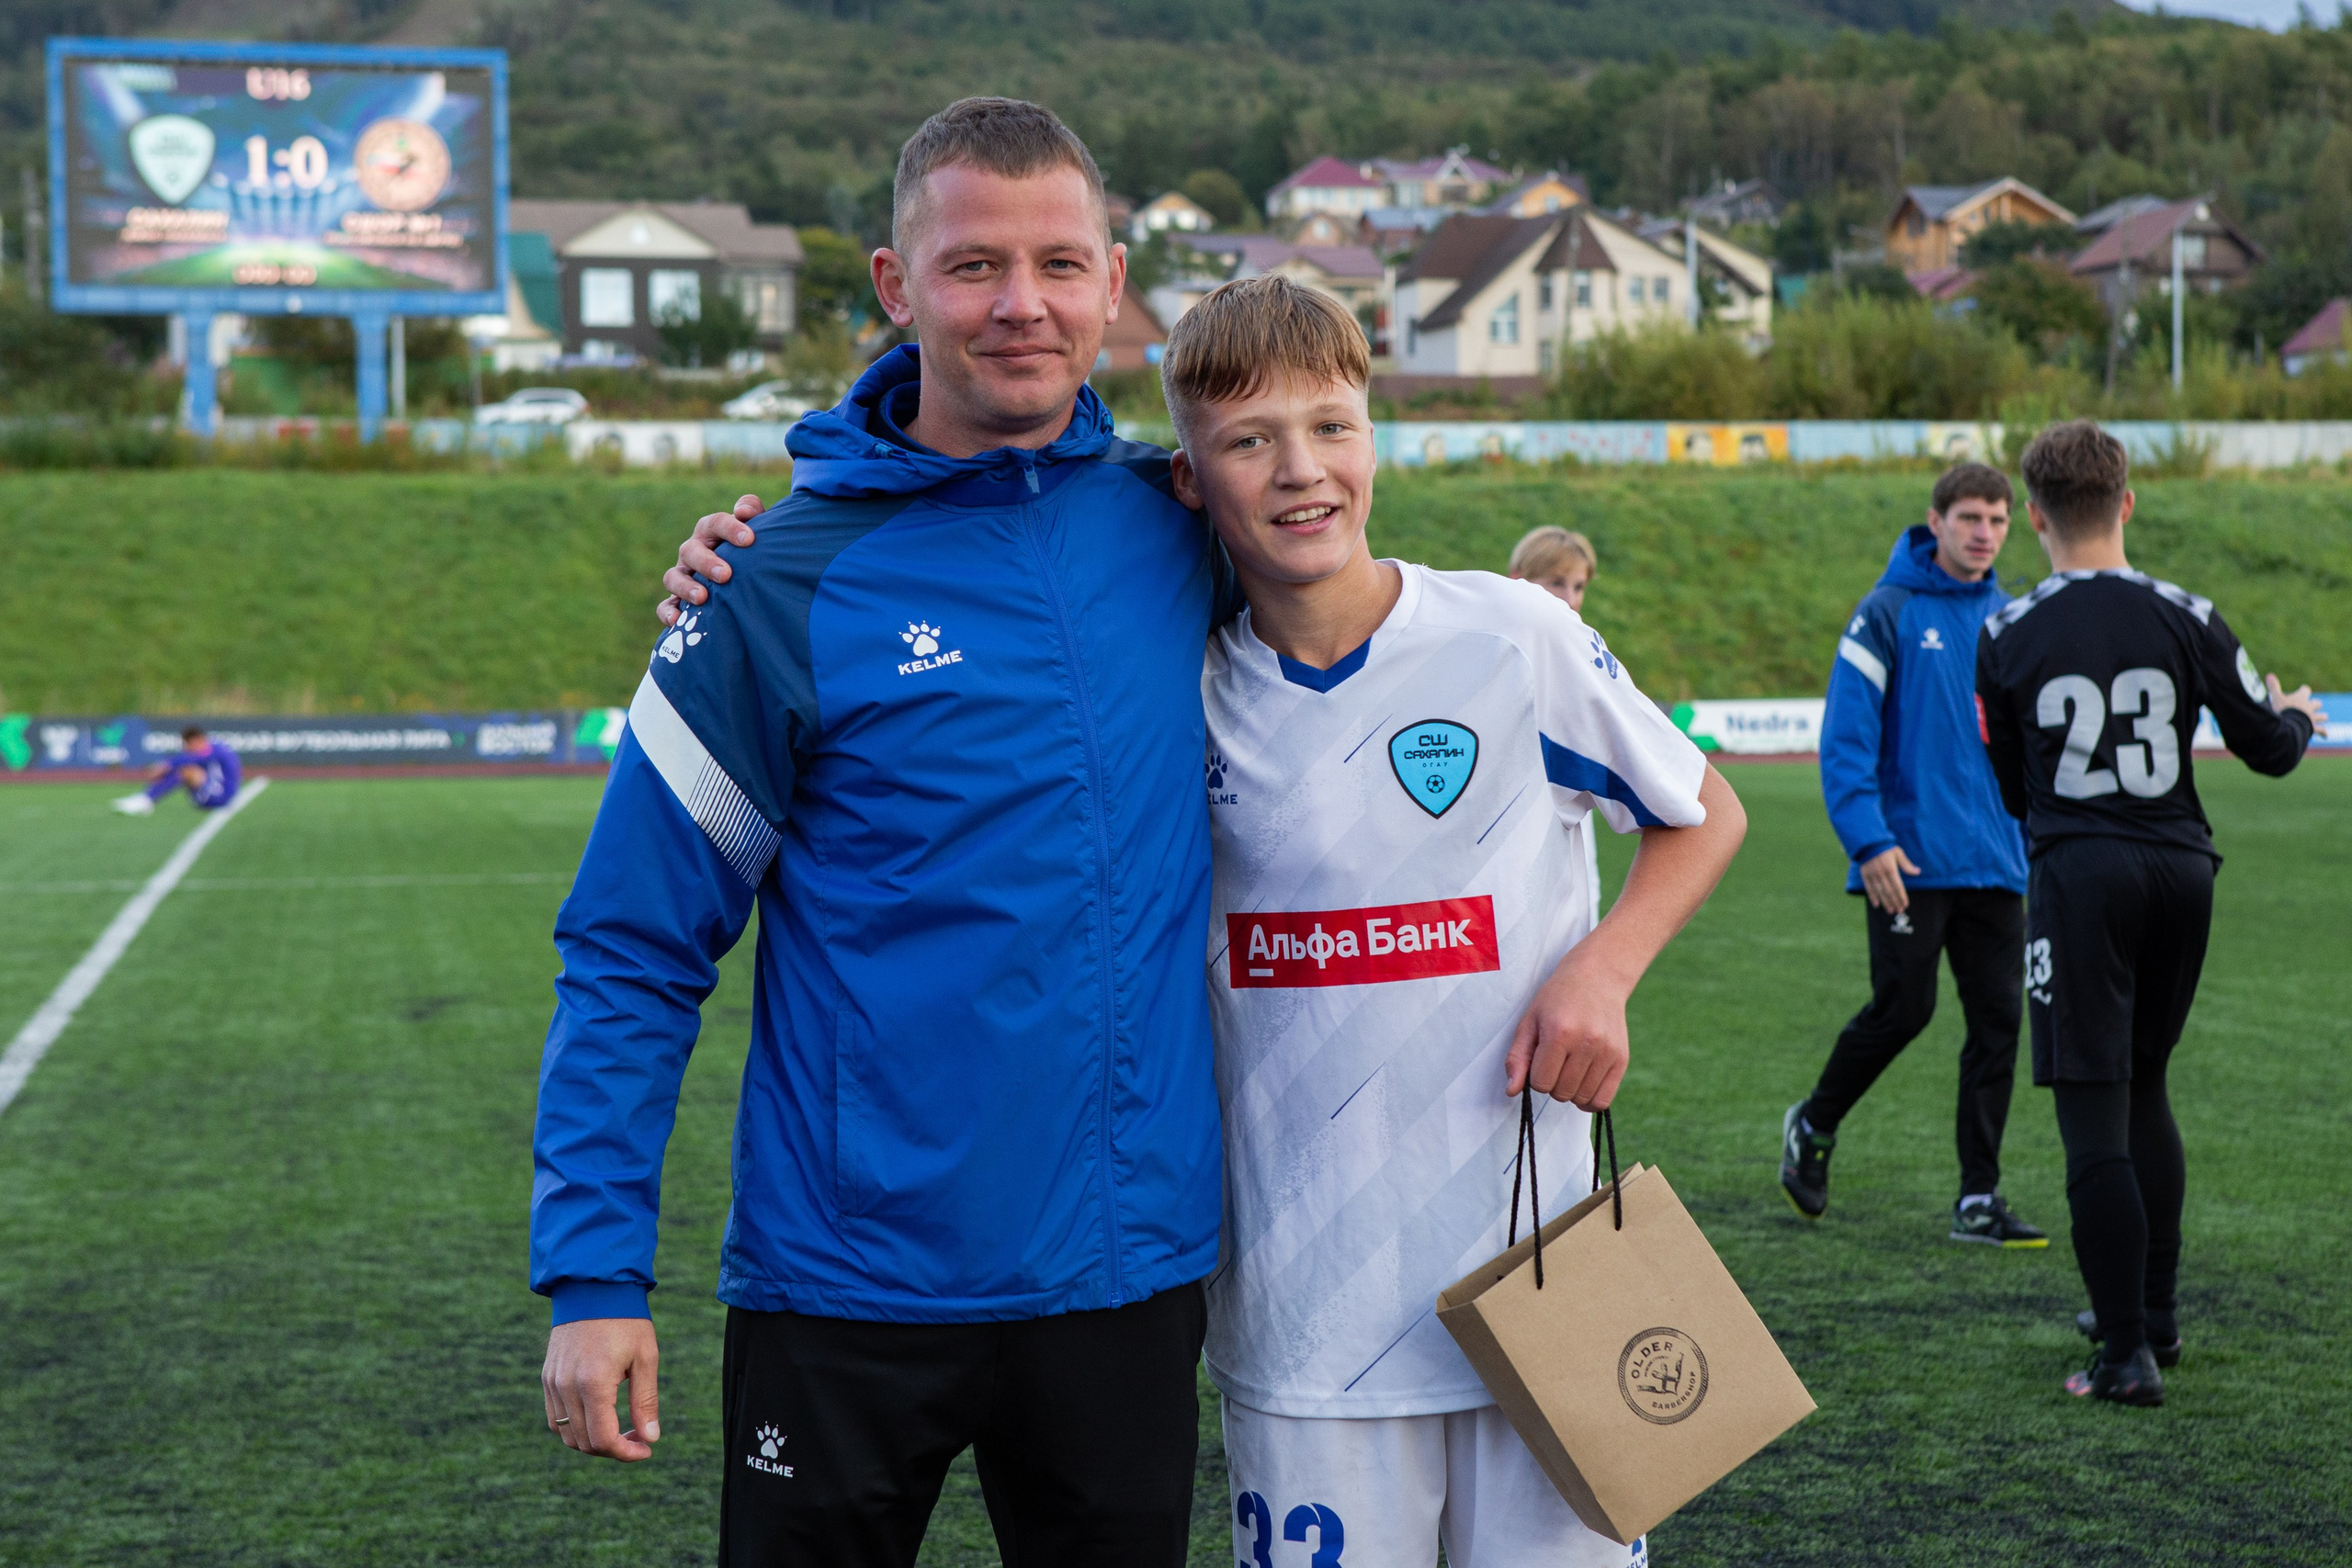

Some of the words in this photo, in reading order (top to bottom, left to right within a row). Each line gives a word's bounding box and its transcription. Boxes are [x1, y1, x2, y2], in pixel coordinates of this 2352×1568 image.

[244, 135, 330, 189] 1:0
[662, 645, 680, 659] KELME
[898, 649, 963, 676] KELME
[1726, 712, 1809, 732] Nedra
[2036, 668, 2180, 800] 23
[1404, 748, 1464, 760] САХАЛИН
[1419, 734, 1448, 747] СШ
[1248, 922, 1360, 970] Альфа
[1366, 918, 1474, 956] Банк
[1631, 1341, 1673, 1380] OLDER
[1651, 1371, 1697, 1410] BARBERSHOP
[746, 1455, 794, 1478] KELME
[1237, 1490, 1345, 1568] 33
